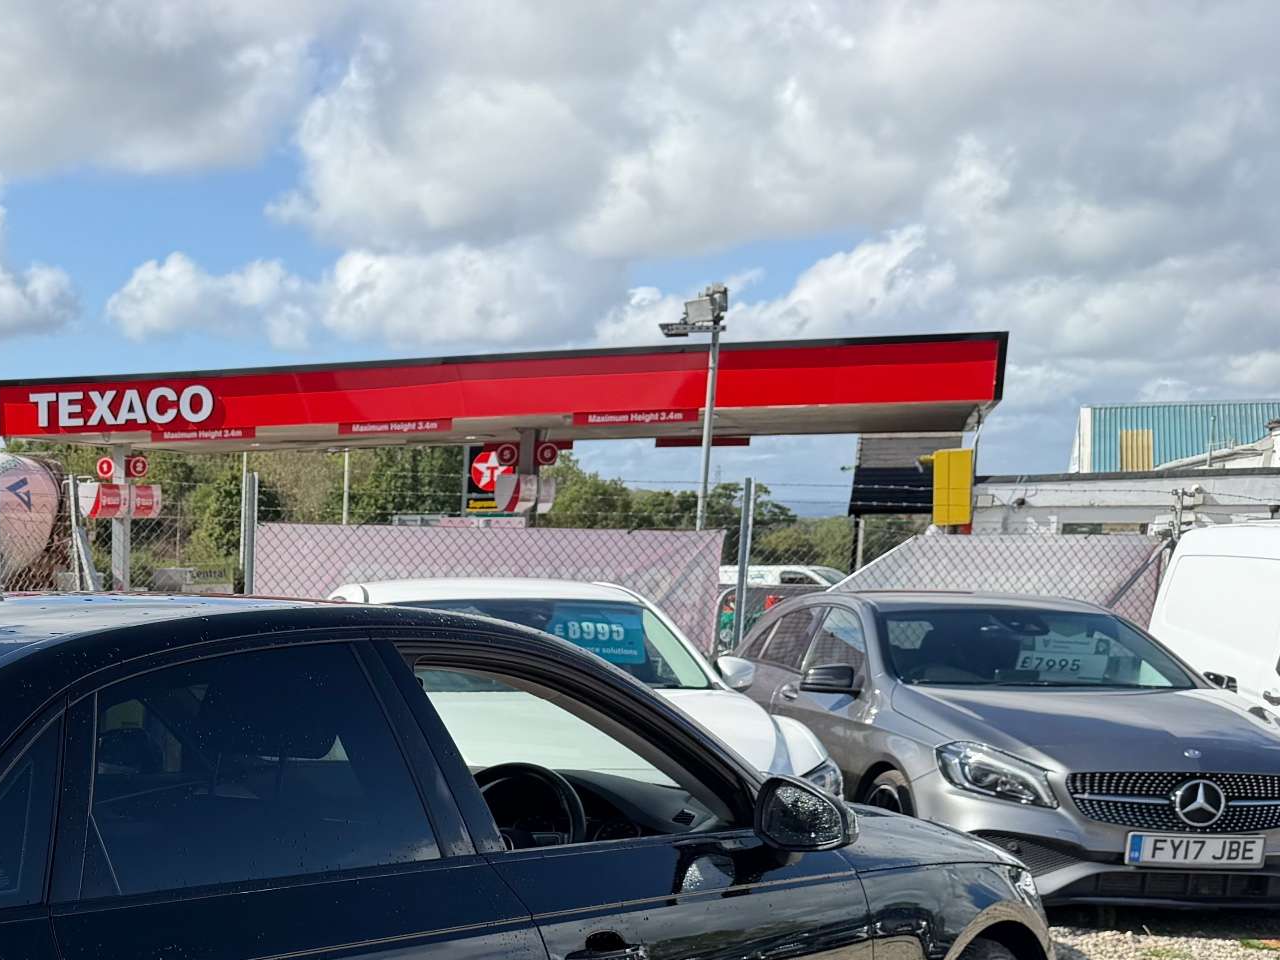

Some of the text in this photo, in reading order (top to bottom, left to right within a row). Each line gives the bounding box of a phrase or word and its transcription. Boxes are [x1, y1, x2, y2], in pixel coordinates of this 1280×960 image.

[28, 385, 214, 428] TEXACO
[587, 411, 684, 423] Maximum Height 3.4m
[351, 420, 438, 432] Maximum Height 3.4m
[163, 431, 198, 439] Maximum
[199, 429, 222, 439] Height
[1020, 656, 1081, 671] £7995
[1151, 838, 1257, 861] FY17 JBE
